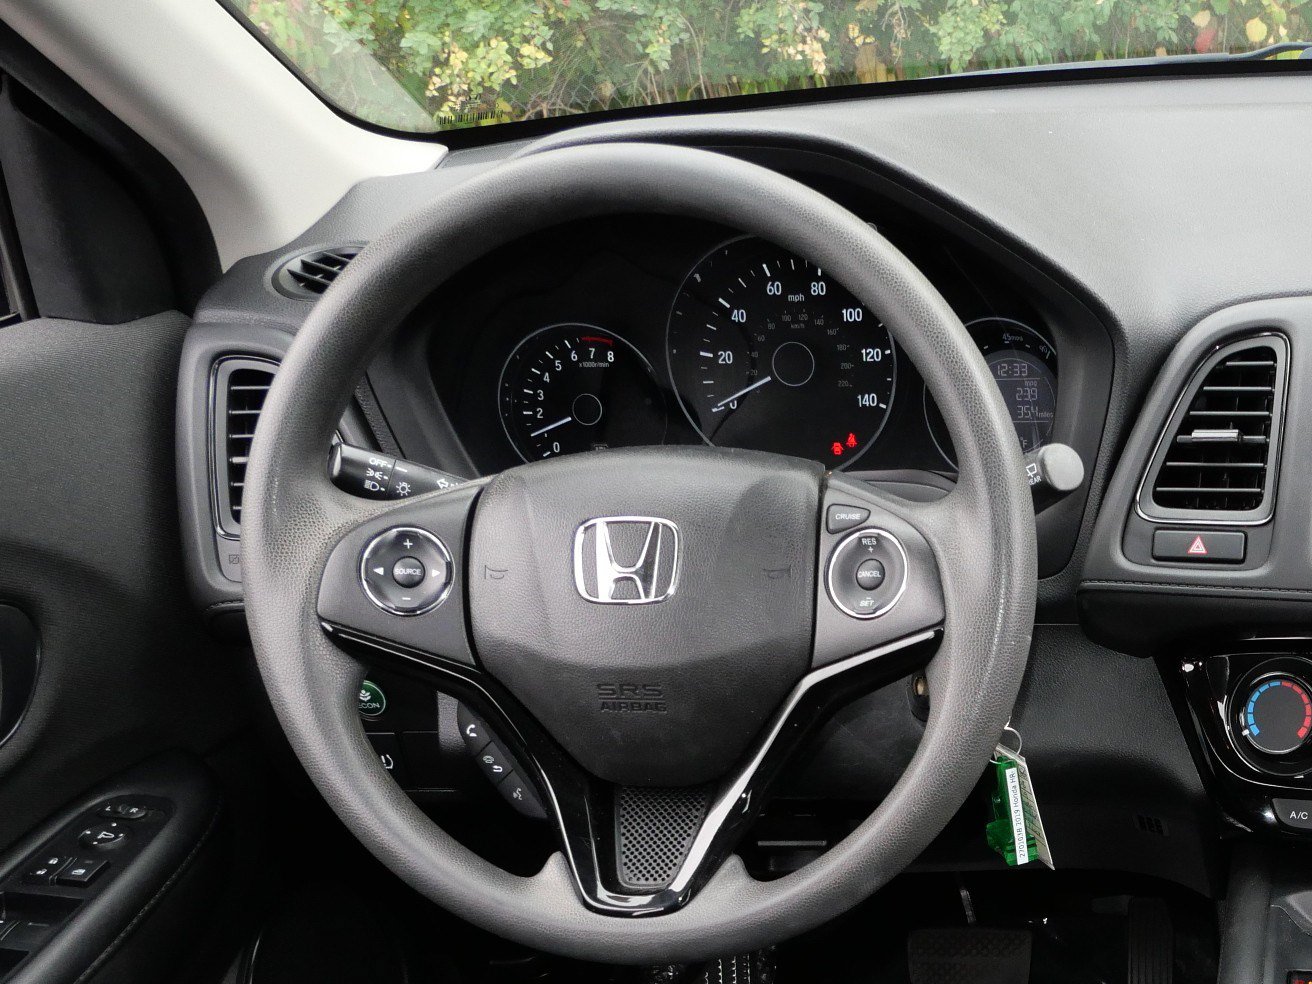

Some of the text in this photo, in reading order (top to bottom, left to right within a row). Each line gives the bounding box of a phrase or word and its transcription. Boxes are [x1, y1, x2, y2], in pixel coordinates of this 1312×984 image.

[766, 282, 782, 295] 60
[810, 282, 826, 296] 80
[788, 294, 805, 302] mph
[731, 309, 747, 323] 40
[782, 314, 792, 322] 100
[842, 308, 862, 322] 100
[814, 318, 824, 326] 140
[570, 351, 578, 361] 6
[588, 348, 596, 358] 7
[607, 351, 615, 362] 8
[718, 351, 733, 364] 20
[861, 349, 882, 362] 120
[554, 360, 562, 371] 5
[997, 363, 1028, 376] 12:33
[543, 372, 550, 383] 4
[537, 389, 544, 400] 3
[857, 393, 878, 407] 140
[536, 408, 544, 419] 2
[553, 442, 561, 453] 0
[369, 458, 387, 467] OFF
[861, 538, 877, 546] RES
[597, 682, 664, 699] SRS
[600, 702, 667, 714] AIRBAG
[1011, 785, 1020, 808] Honda
[1289, 811, 1308, 821] A/C
